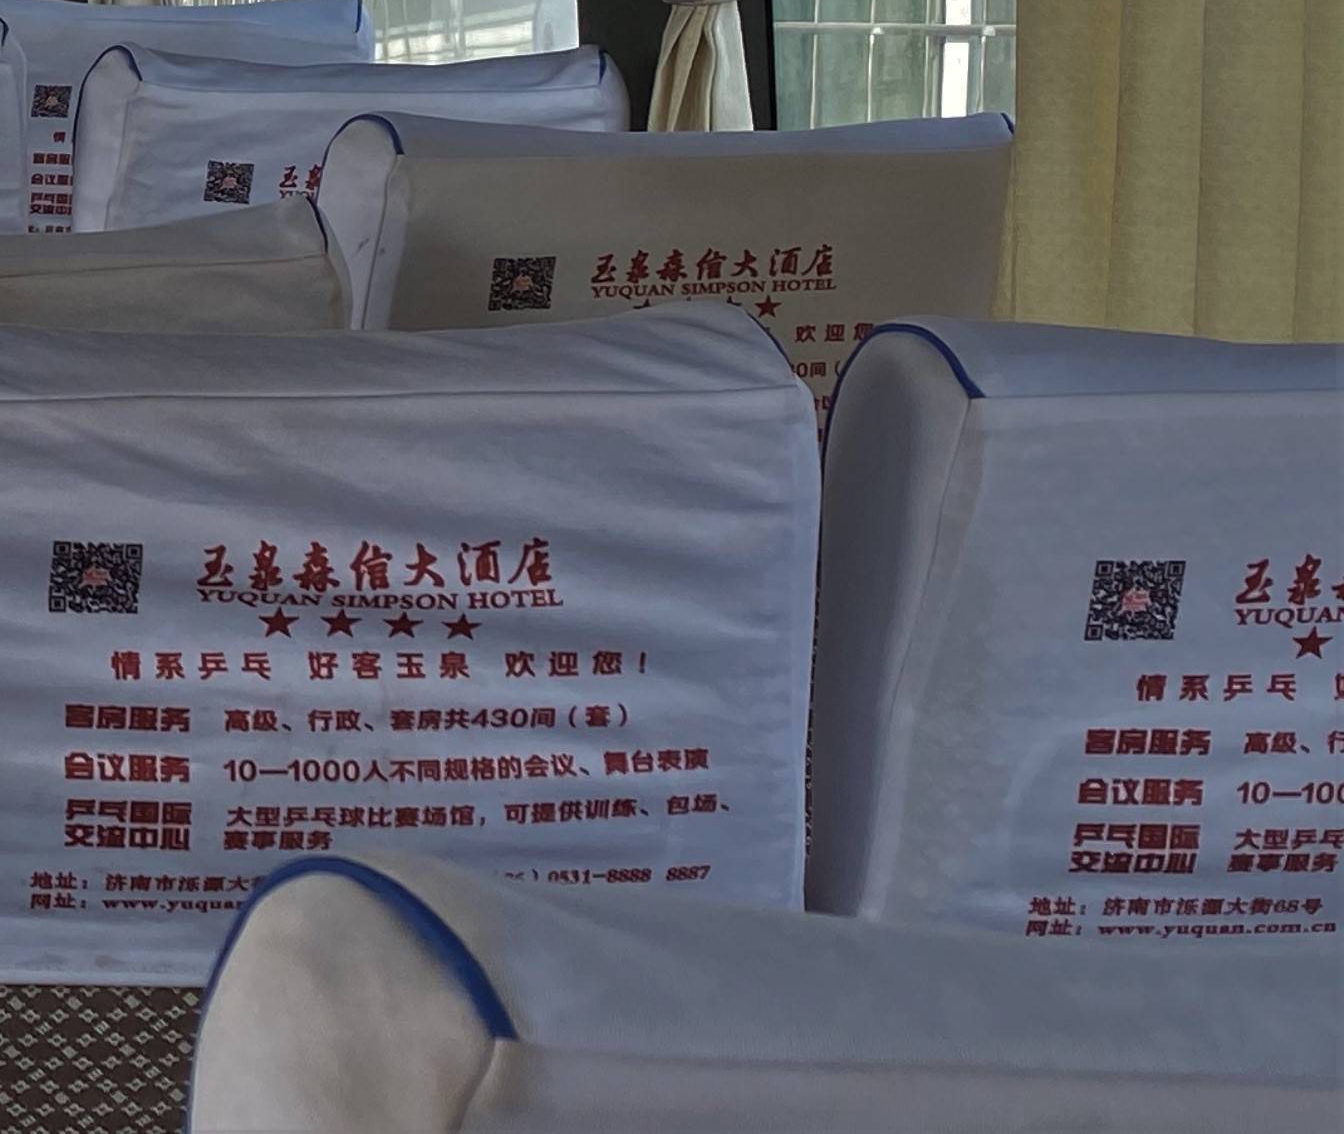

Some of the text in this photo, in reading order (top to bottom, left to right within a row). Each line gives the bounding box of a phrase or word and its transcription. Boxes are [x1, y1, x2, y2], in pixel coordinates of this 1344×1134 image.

[591, 245, 834, 283] 玉泉森信大酒店
[591, 278, 837, 299] YUQUAN SIMPSON HOTEL
[198, 540, 553, 590] 玉泉森信大酒店
[1234, 553, 1344, 606] 玉泉
[196, 588, 563, 613] YUQUAN SIMPSON HOTEL
[111, 650, 645, 680] 情系乒乓 好客玉泉 欢迎您！
[1136, 674, 1295, 701] 情系乒乓
[66, 704, 189, 732] 客房服务
[1086, 729, 1209, 754] 客房服务
[65, 753, 189, 782] 会议服务
[1079, 779, 1202, 805] 会议服务
[65, 799, 191, 826] 乒乓国际
[224, 830, 331, 850] 赛事服务
[1074, 824, 1199, 850] 乒乓国际
